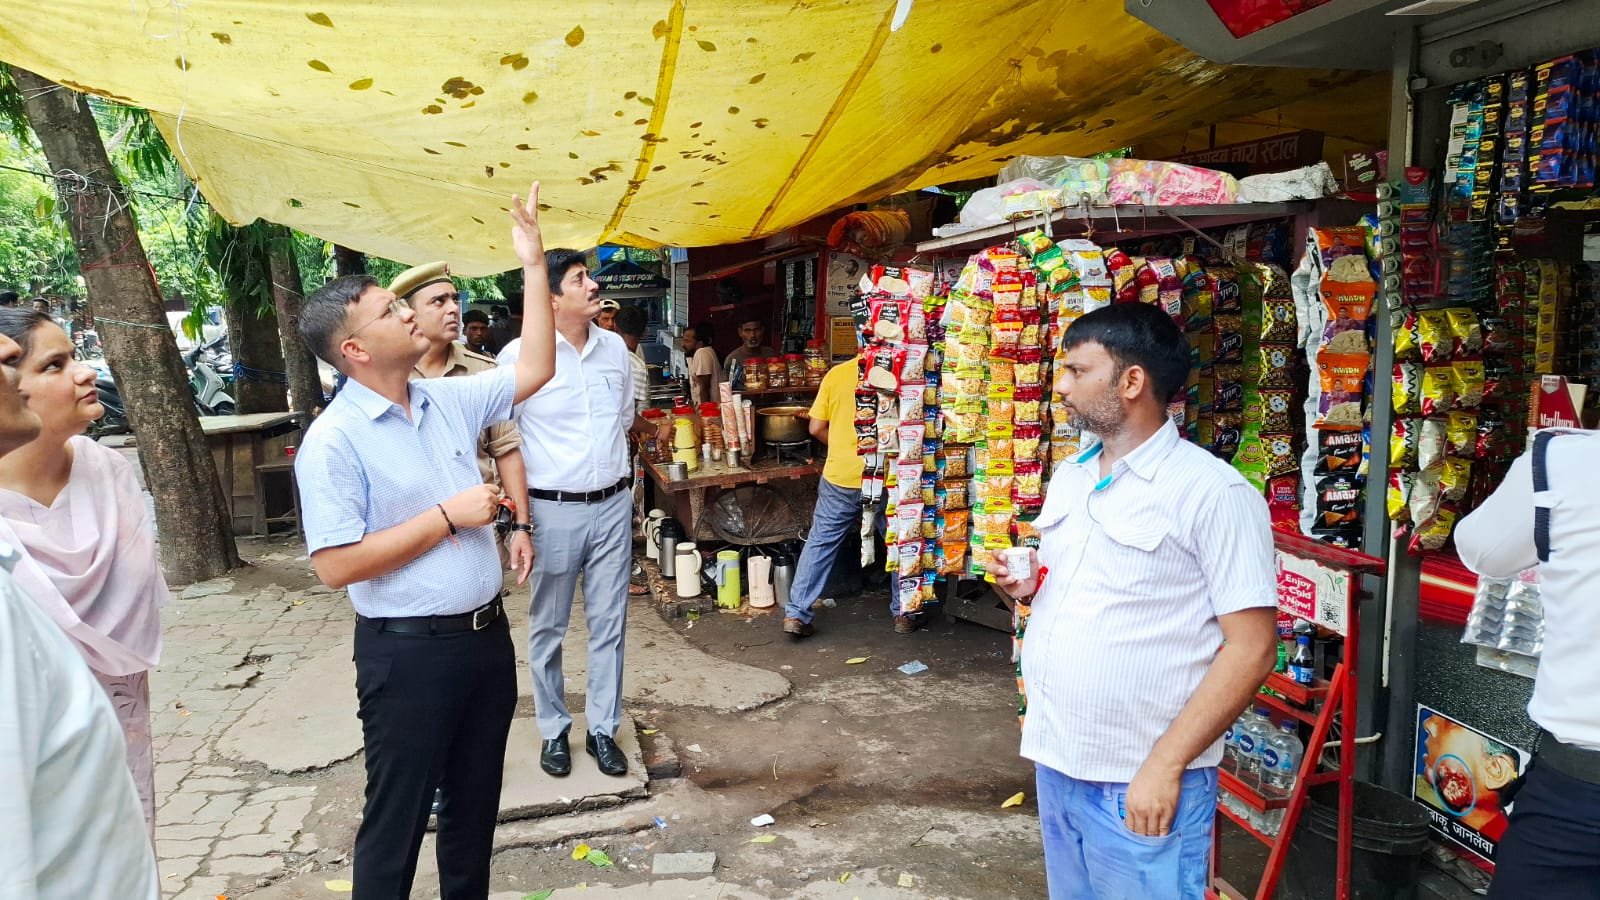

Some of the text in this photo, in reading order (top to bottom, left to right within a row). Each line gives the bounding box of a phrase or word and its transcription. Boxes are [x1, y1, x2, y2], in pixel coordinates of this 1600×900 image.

[1285, 573, 1311, 590] Enjoy
[1286, 595, 1311, 611] Now!
[1452, 821, 1495, 855] जानलेवा
